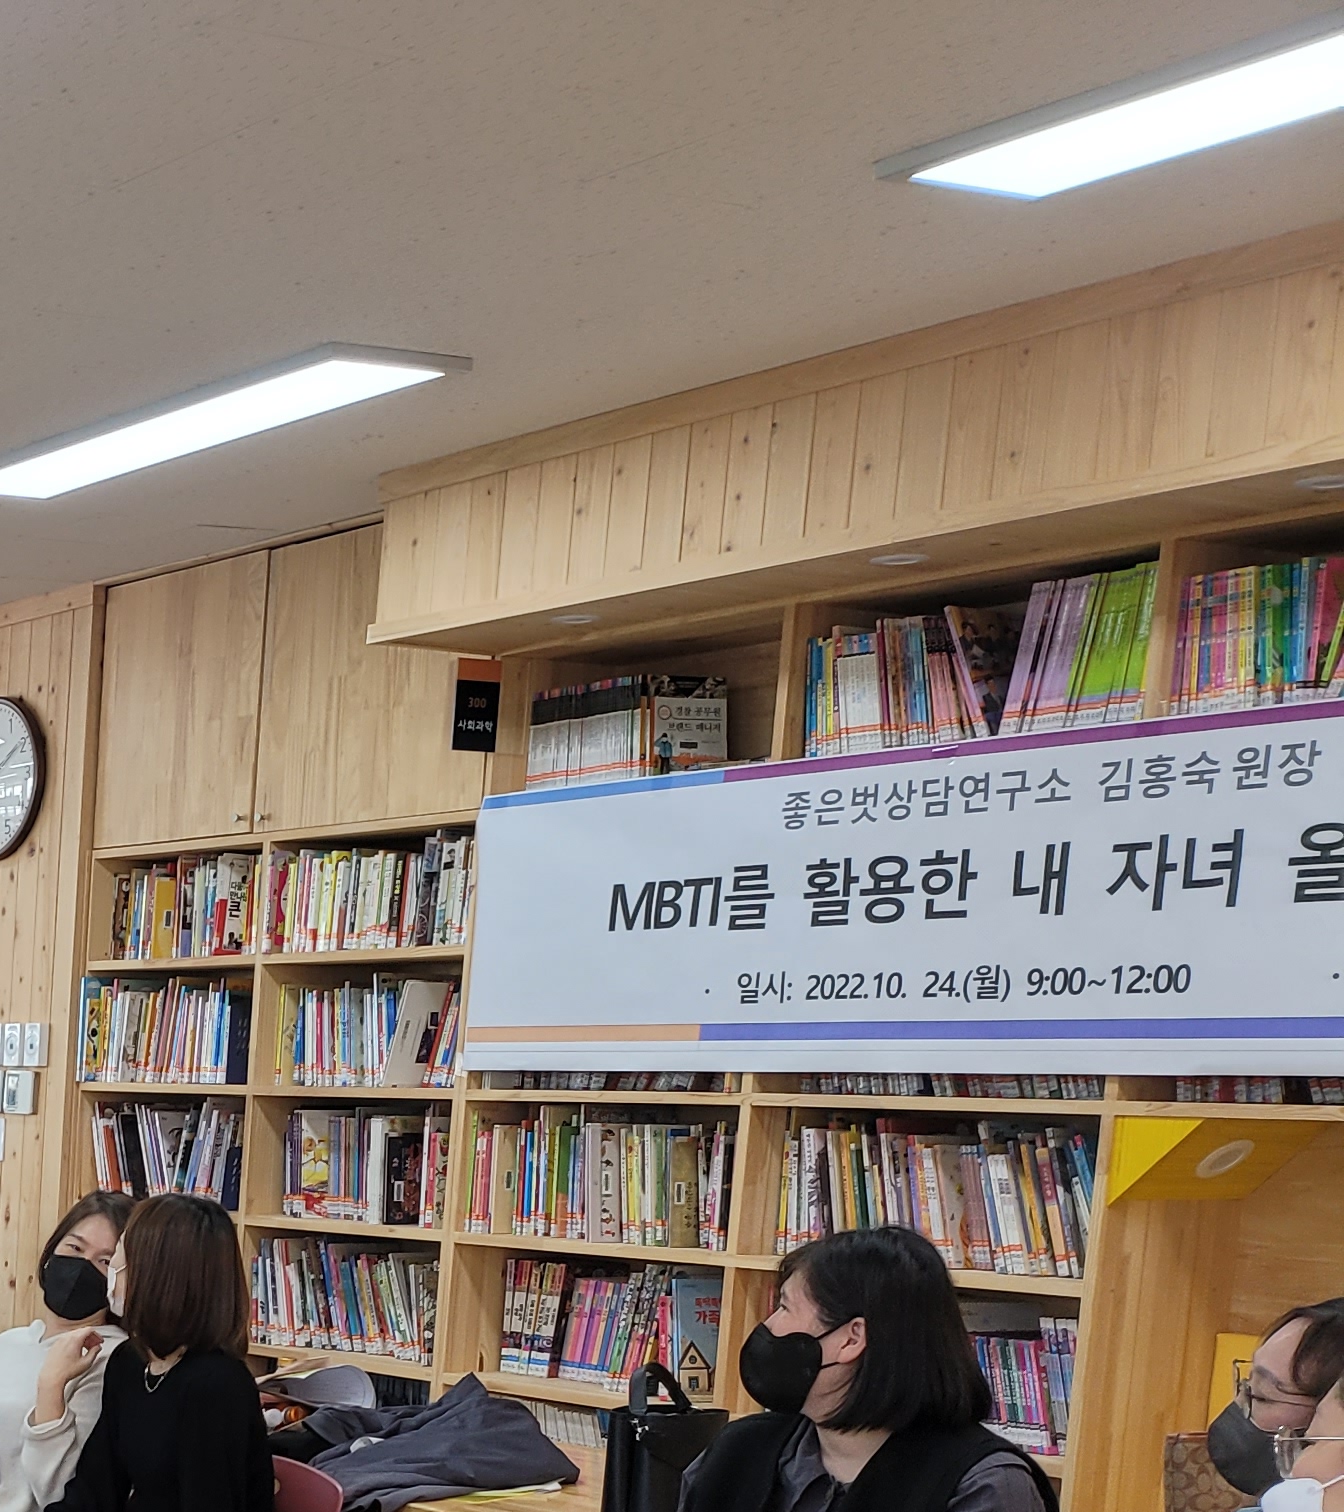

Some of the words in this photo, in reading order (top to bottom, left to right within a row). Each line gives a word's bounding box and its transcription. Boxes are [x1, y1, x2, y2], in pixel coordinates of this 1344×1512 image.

[468, 697, 487, 708] 300
[457, 719, 494, 733] 사회과학
[19, 736, 27, 754] 2
[781, 767, 1072, 831] 좋은벗상담연구소
[1097, 753, 1222, 804] 김홍숙
[1232, 739, 1322, 790] 원장
[4, 819, 12, 836] 5
[608, 863, 776, 932] MBTI를
[802, 848, 979, 928] 활용한
[1012, 841, 1072, 916] 내
[1105, 828, 1246, 912] 자녀
[737, 971, 793, 1004] 일시:
[805, 971, 907, 1001] 2022.10.
[922, 964, 1011, 1004] 24.(월)
[1026, 963, 1192, 998] 9:00~12:00
